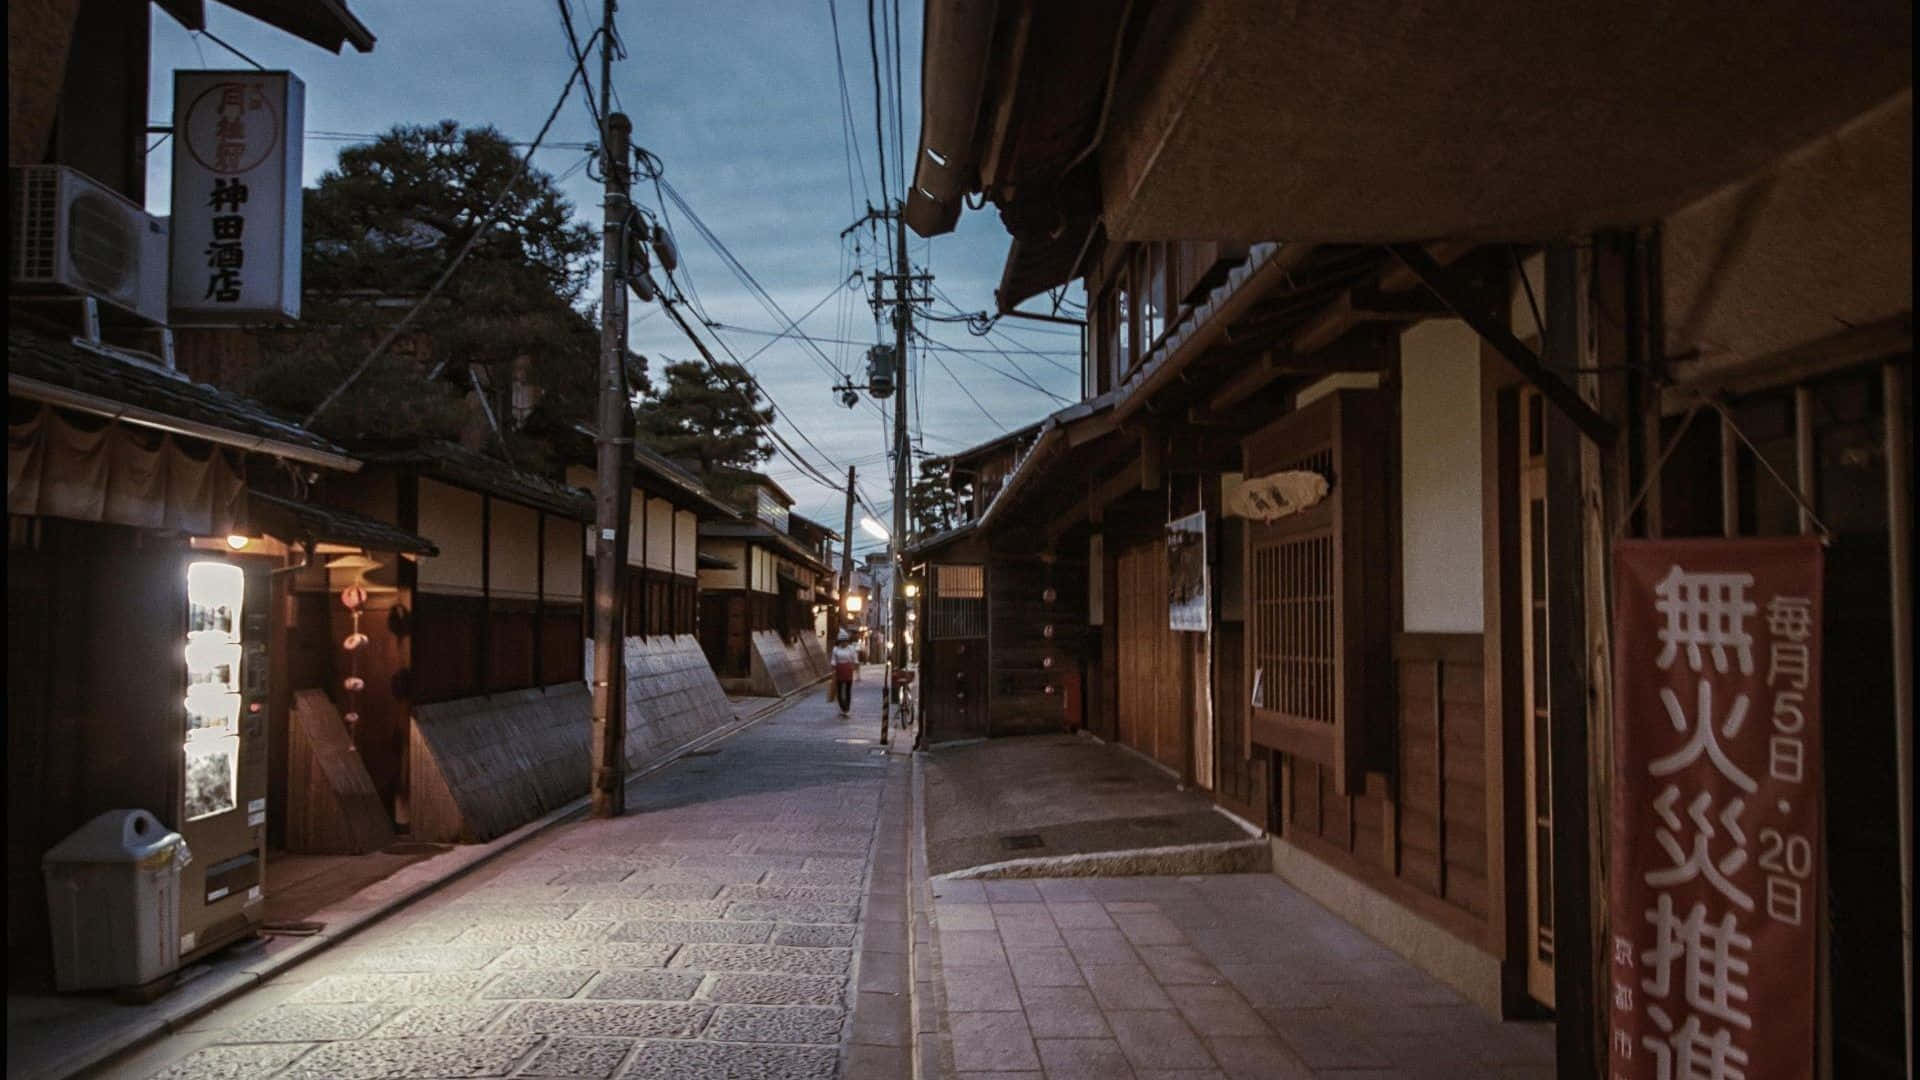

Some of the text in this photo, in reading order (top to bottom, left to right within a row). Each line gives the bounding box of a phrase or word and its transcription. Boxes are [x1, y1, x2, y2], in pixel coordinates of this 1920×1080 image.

[204, 178, 248, 302] 神田酒店
[1642, 564, 1757, 1080] 無火災推進
[1614, 936, 1634, 1080] 京都市
